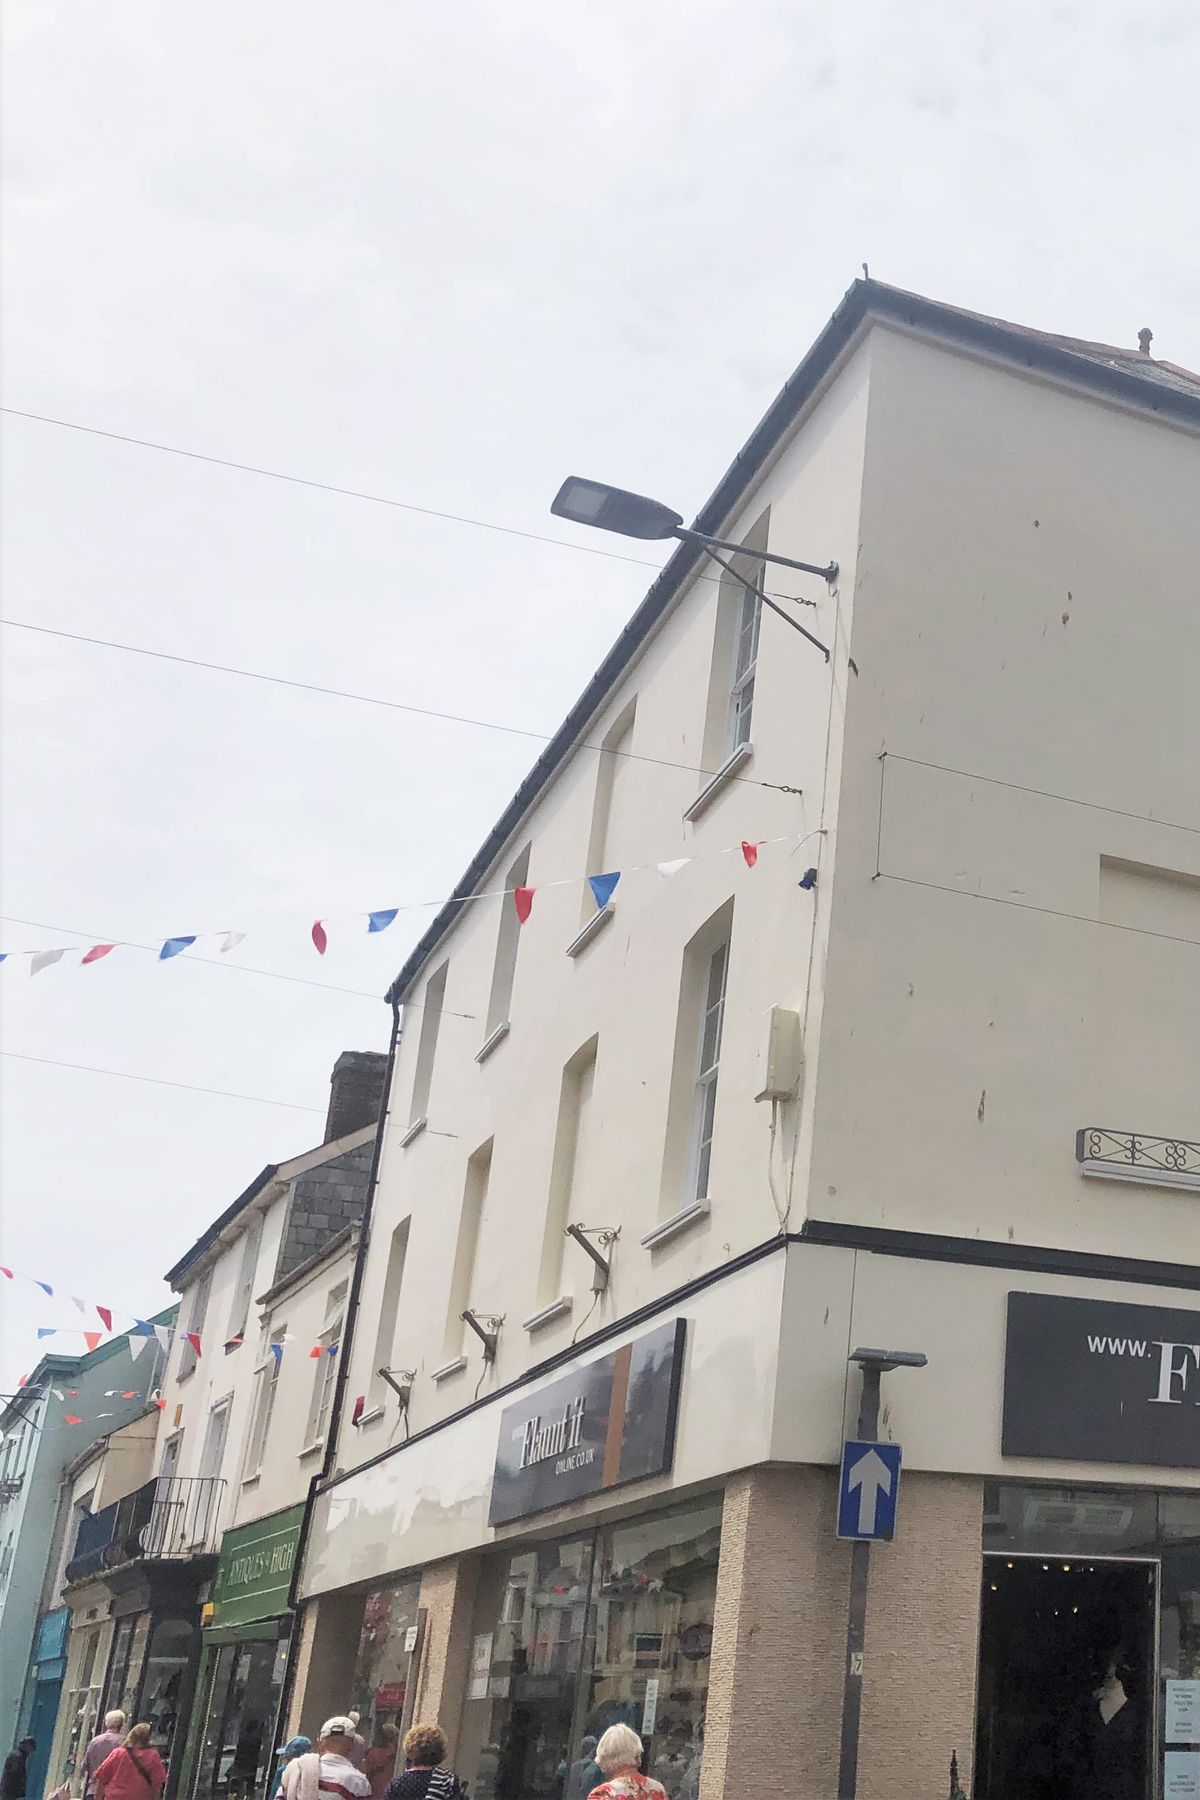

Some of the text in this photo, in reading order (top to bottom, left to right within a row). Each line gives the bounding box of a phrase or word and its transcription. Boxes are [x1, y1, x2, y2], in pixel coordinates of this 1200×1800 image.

[519, 1396, 586, 1470] Flaunt it
[269, 1541, 295, 1574] HIGH
